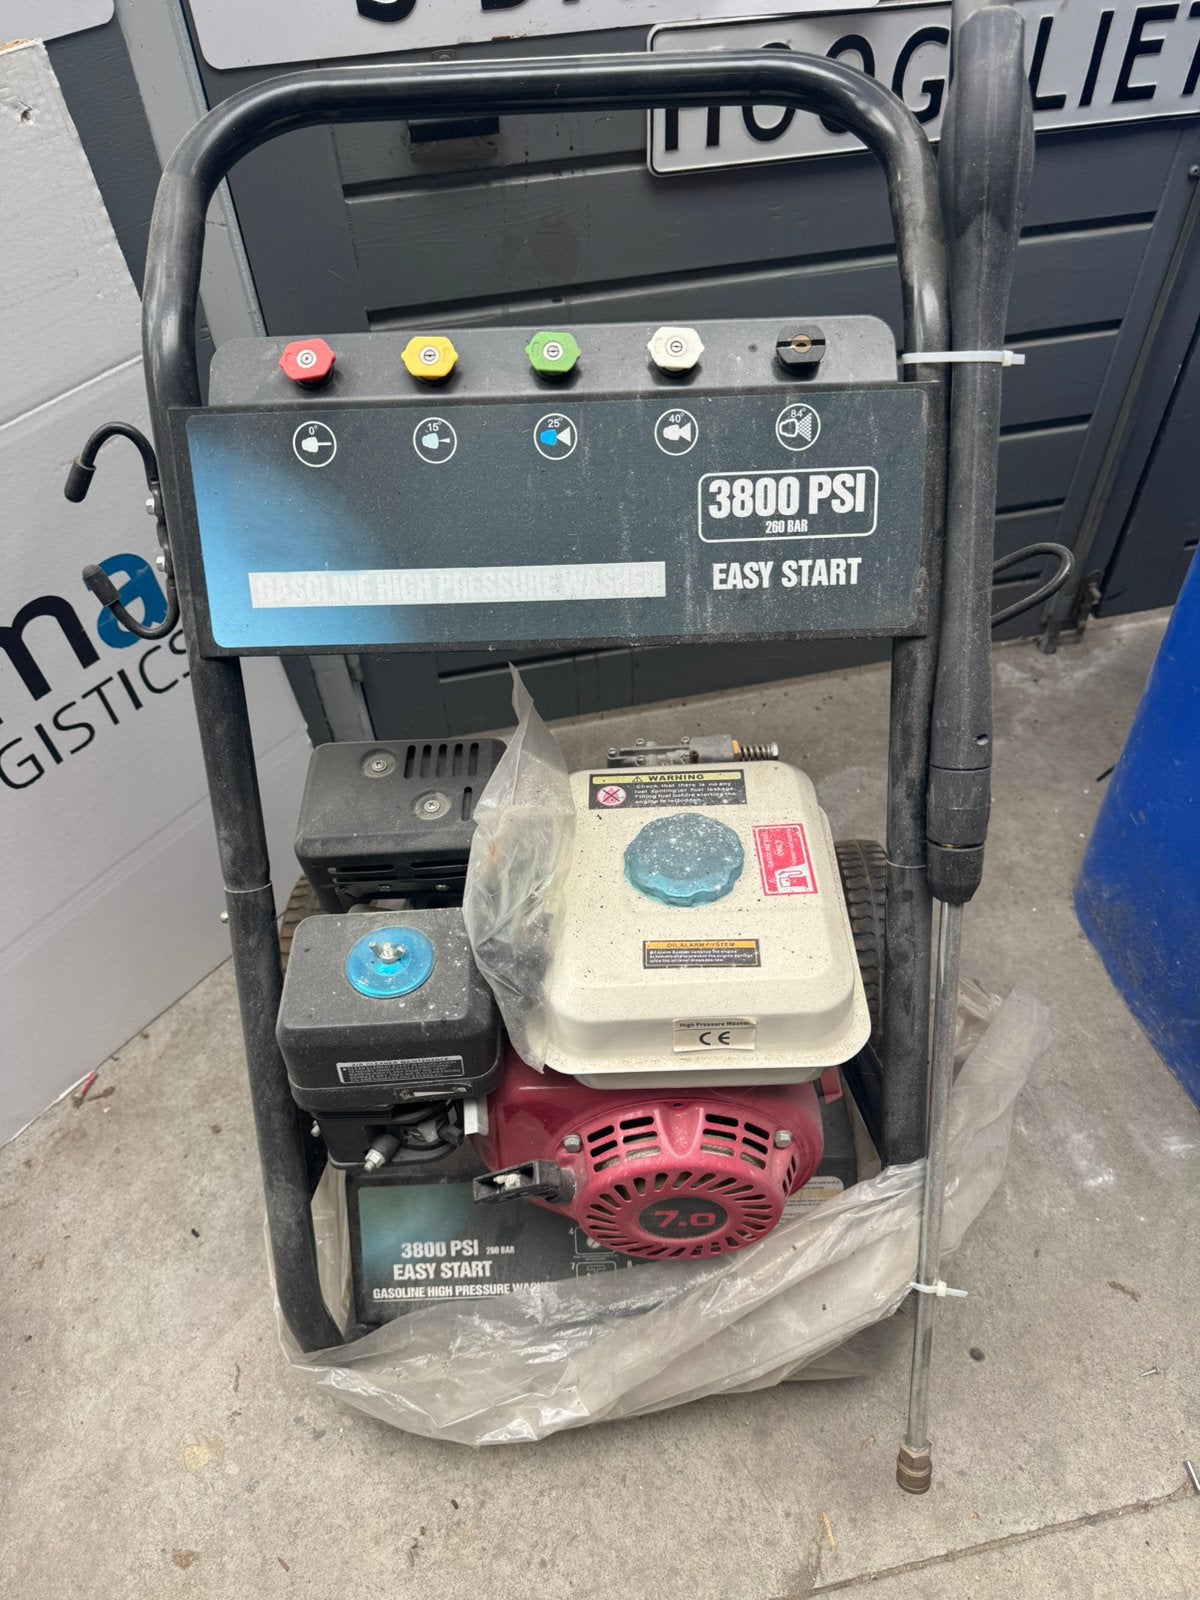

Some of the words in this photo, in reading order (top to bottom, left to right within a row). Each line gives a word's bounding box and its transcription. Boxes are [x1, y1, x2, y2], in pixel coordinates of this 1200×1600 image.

[669, 412, 684, 424] 40°
[790, 407, 806, 418] 84°
[308, 424, 318, 436] 0°
[427, 420, 442, 432] 15°
[548, 417, 562, 428] 25°
[708, 476, 800, 518] 3800
[808, 472, 866, 514] PSI
[765, 520, 785, 534] 260
[787, 519, 808, 532] BAR
[712, 561, 774, 590] EASY
[782, 558, 862, 588] START
[699, 1031, 730, 1046] CE
[654, 1210, 716, 1228] 7.0
[401, 1242, 447, 1258] 3800
[450, 1240, 478, 1256] PSI
[500, 1246, 515, 1254] BAR
[393, 1262, 435, 1280] EASY
[440, 1260, 492, 1278] START
[372, 1286, 426, 1299] GASOLINE
[427, 1286, 452, 1298] HIGH
[455, 1284, 510, 1296] PRESSURE
